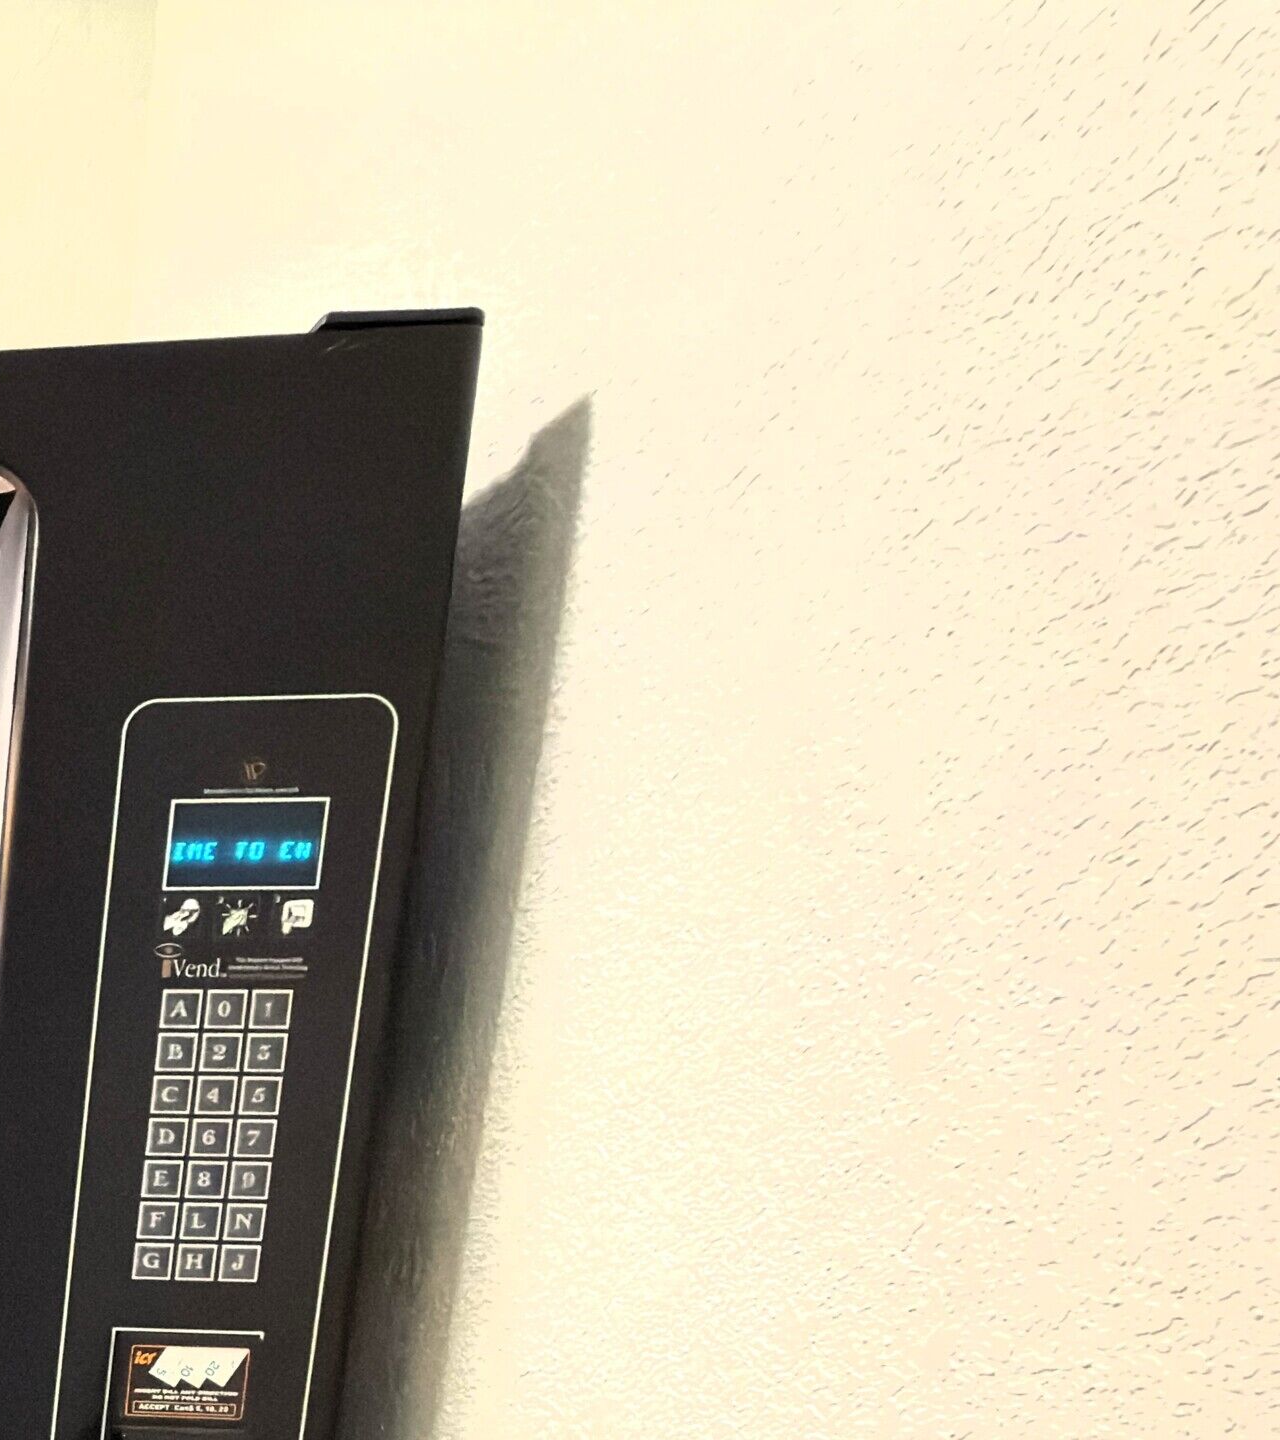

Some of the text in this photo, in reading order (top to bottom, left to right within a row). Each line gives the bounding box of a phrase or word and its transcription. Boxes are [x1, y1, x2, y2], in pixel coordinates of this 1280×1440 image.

[234, 841, 267, 860] TO
[169, 999, 188, 1018] A
[166, 1043, 184, 1060] B
[211, 1043, 227, 1061] 2
[161, 1086, 179, 1103] C
[206, 1087, 220, 1104] 4
[156, 1127, 176, 1146] D
[201, 1129, 217, 1146] 6
[246, 1130, 261, 1147] 7
[152, 1169, 170, 1187] E
[196, 1170, 211, 1188] 8
[148, 1211, 166, 1229] F
[190, 1212, 206, 1229] L
[233, 1212, 253, 1230] N
[142, 1252, 161, 1269] G
[185, 1252, 204, 1270] H
[231, 1254, 245, 1271] J
